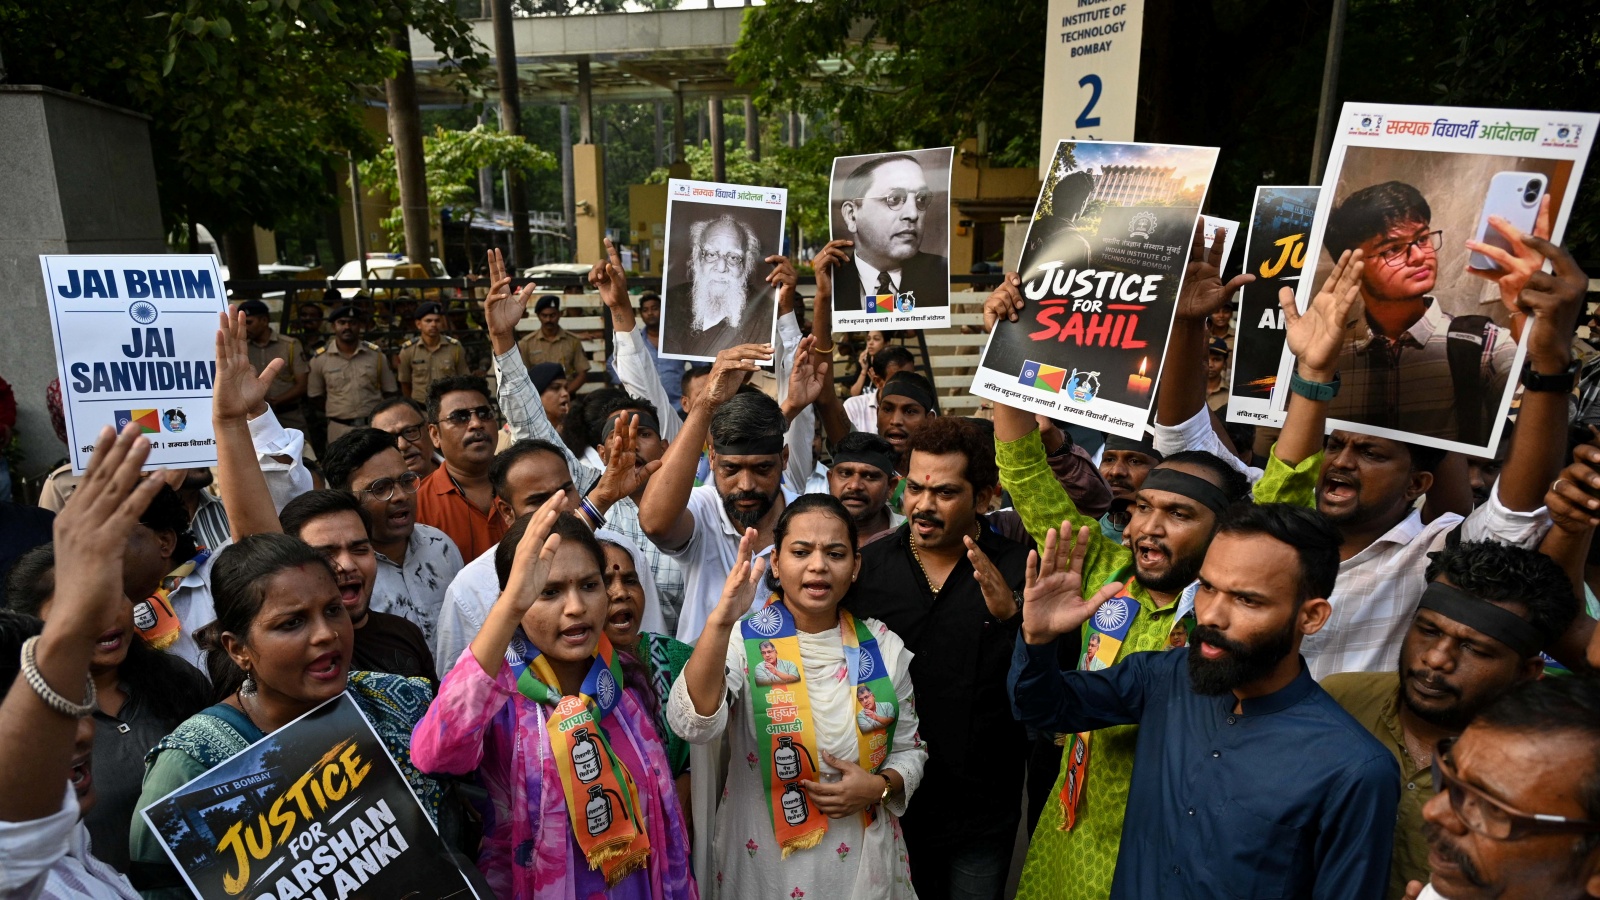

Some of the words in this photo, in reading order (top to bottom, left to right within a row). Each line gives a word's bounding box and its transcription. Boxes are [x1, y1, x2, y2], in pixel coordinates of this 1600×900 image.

[1062, 8, 1110, 27] INSTITUTE
[1112, 4, 1127, 16] OF
[1061, 21, 1126, 43] TECHNOLOGY
[1070, 40, 1113, 58] BOMBAY
[1075, 73, 1103, 129] 2
[1386, 120, 1432, 136] सम्यक
[1431, 118, 1480, 139] विद्यार्थी
[1478, 121, 1540, 143] आंदोलन
[692, 188, 715, 198] सम्यक
[715, 188, 736, 199] विद्यार्थी
[737, 190, 763, 202] आंदोलन
[1101, 253, 1141, 265] TECHNOLOGY
[1141, 260, 1172, 271] BOMBAY
[1104, 246, 1126, 255] INDIAN
[1126, 249, 1160, 261] INSTITUTE
[57, 269, 119, 299] JAI
[123, 269, 216, 299] BHIM
[1024, 259, 1166, 303] JUSTICE
[1071, 298, 1103, 313] FOR
[1028, 305, 1148, 349] SAHIL
[122, 327, 176, 359] JAI
[70, 361, 216, 393] SANVIDHA
[1063, 406, 1085, 416] सम्यक
[1107, 416, 1135, 429] आंदोलन
[765, 688, 796, 704] वंचित
[766, 705, 798, 721] बहुजन
[766, 718, 803, 735] आघाडी
[213, 783, 230, 796] IIT
[232, 771, 272, 791] BOMBAY
[215, 742, 373, 896] JUSTICE
[288, 821, 328, 860] FOR
